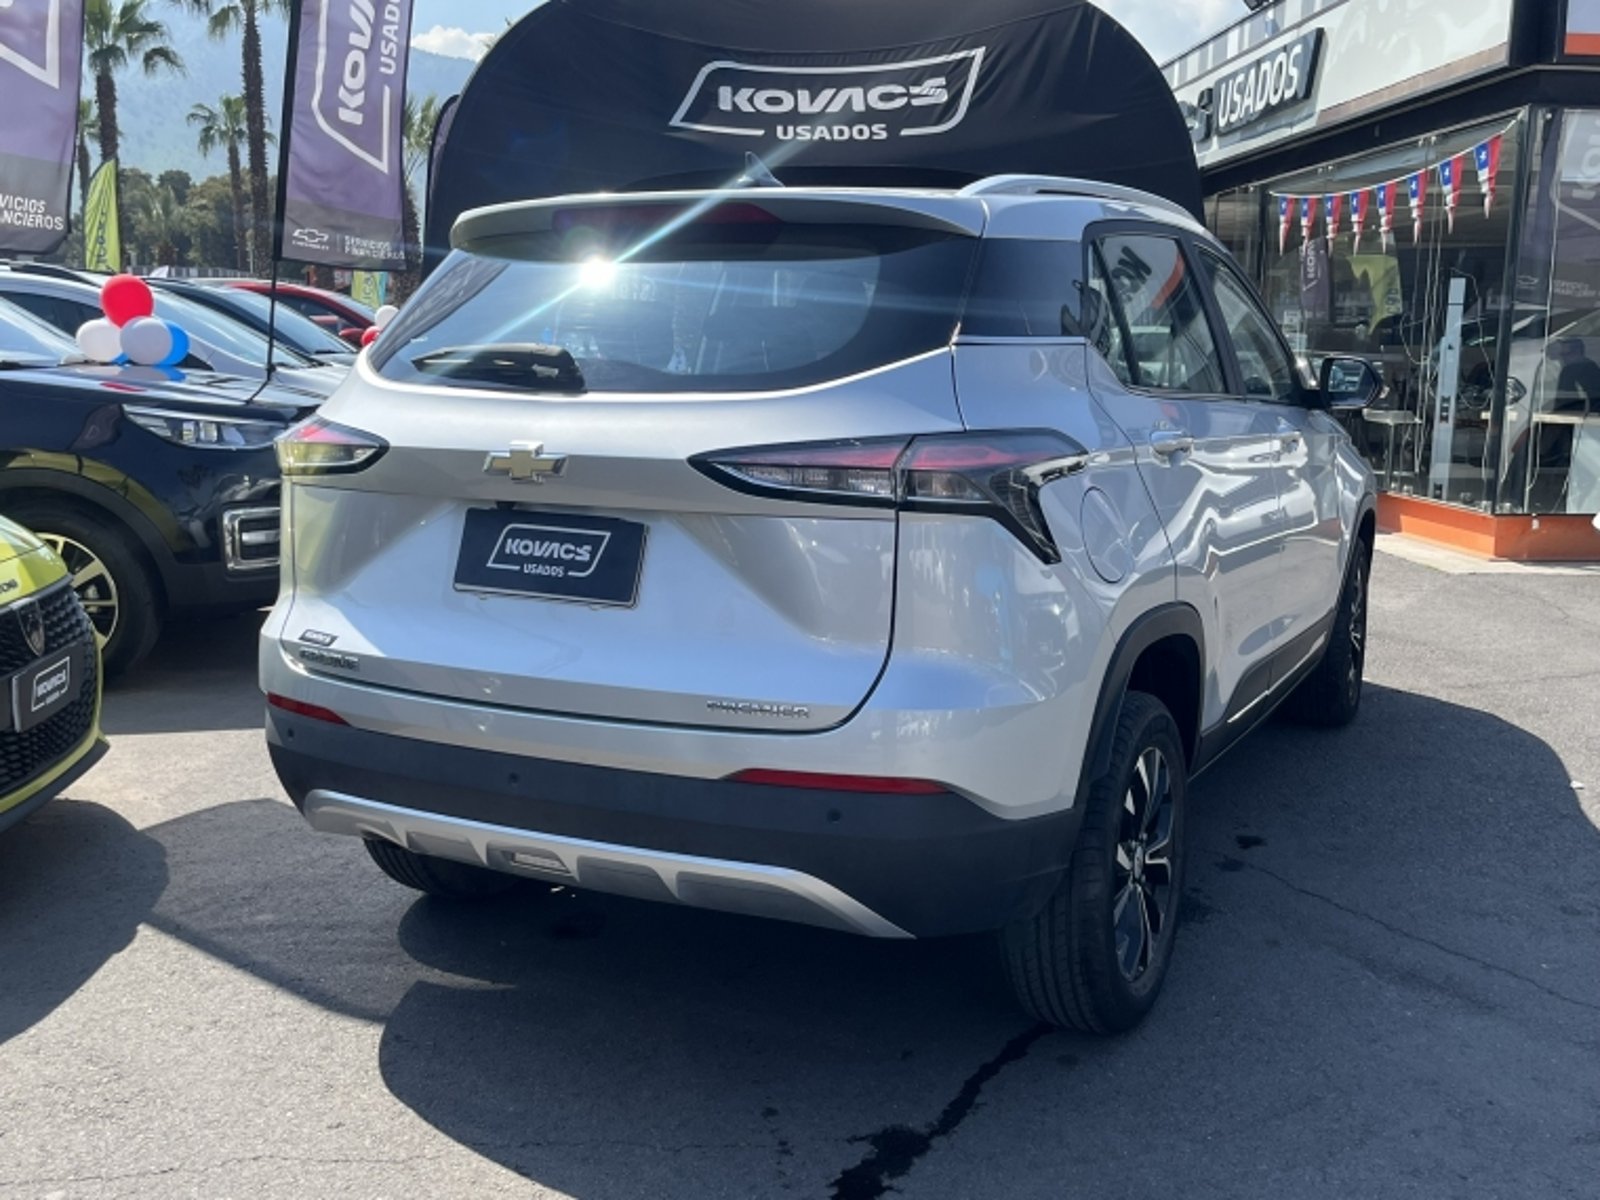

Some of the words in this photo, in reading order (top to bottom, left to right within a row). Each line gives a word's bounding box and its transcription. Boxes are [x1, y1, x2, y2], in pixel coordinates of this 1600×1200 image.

[718, 77, 948, 114] KOVACS
[1218, 43, 1303, 128] USADOS
[775, 123, 889, 142] USADOS
[504, 537, 593, 562] KOVACS
[523, 563, 565, 578] USADOS
[706, 700, 810, 719] PREMIER
